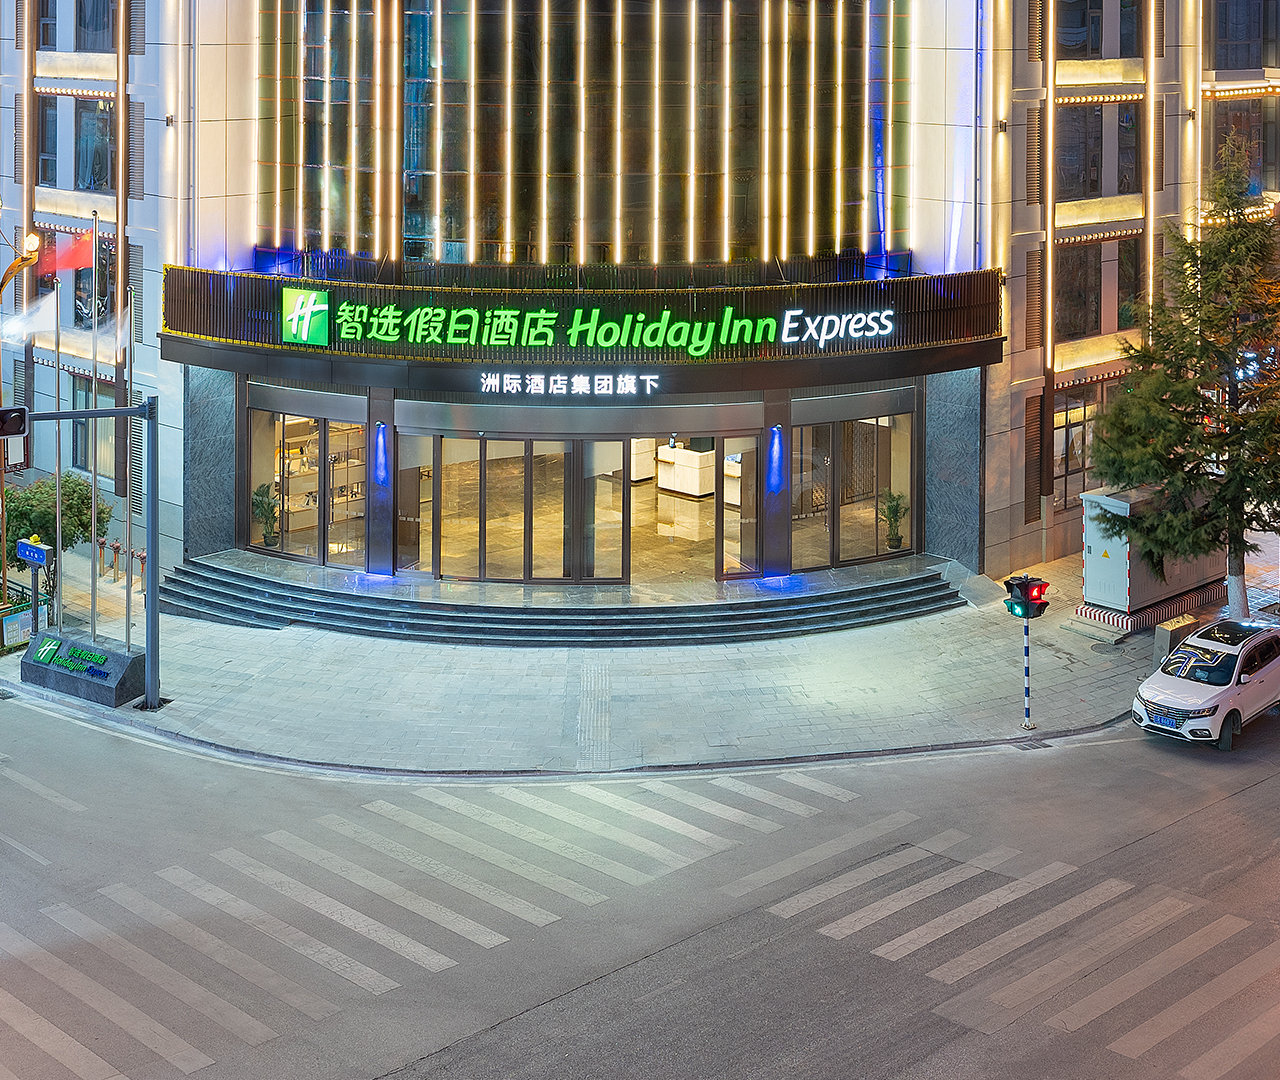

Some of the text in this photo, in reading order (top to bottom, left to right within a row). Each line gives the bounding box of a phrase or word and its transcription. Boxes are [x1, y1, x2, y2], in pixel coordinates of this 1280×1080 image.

[336, 300, 894, 356] 智选假日酒店 Holiday Inn Express
[480, 373, 660, 396] 洲际酒店集团旗下
[52, 655, 77, 671] Holiday
